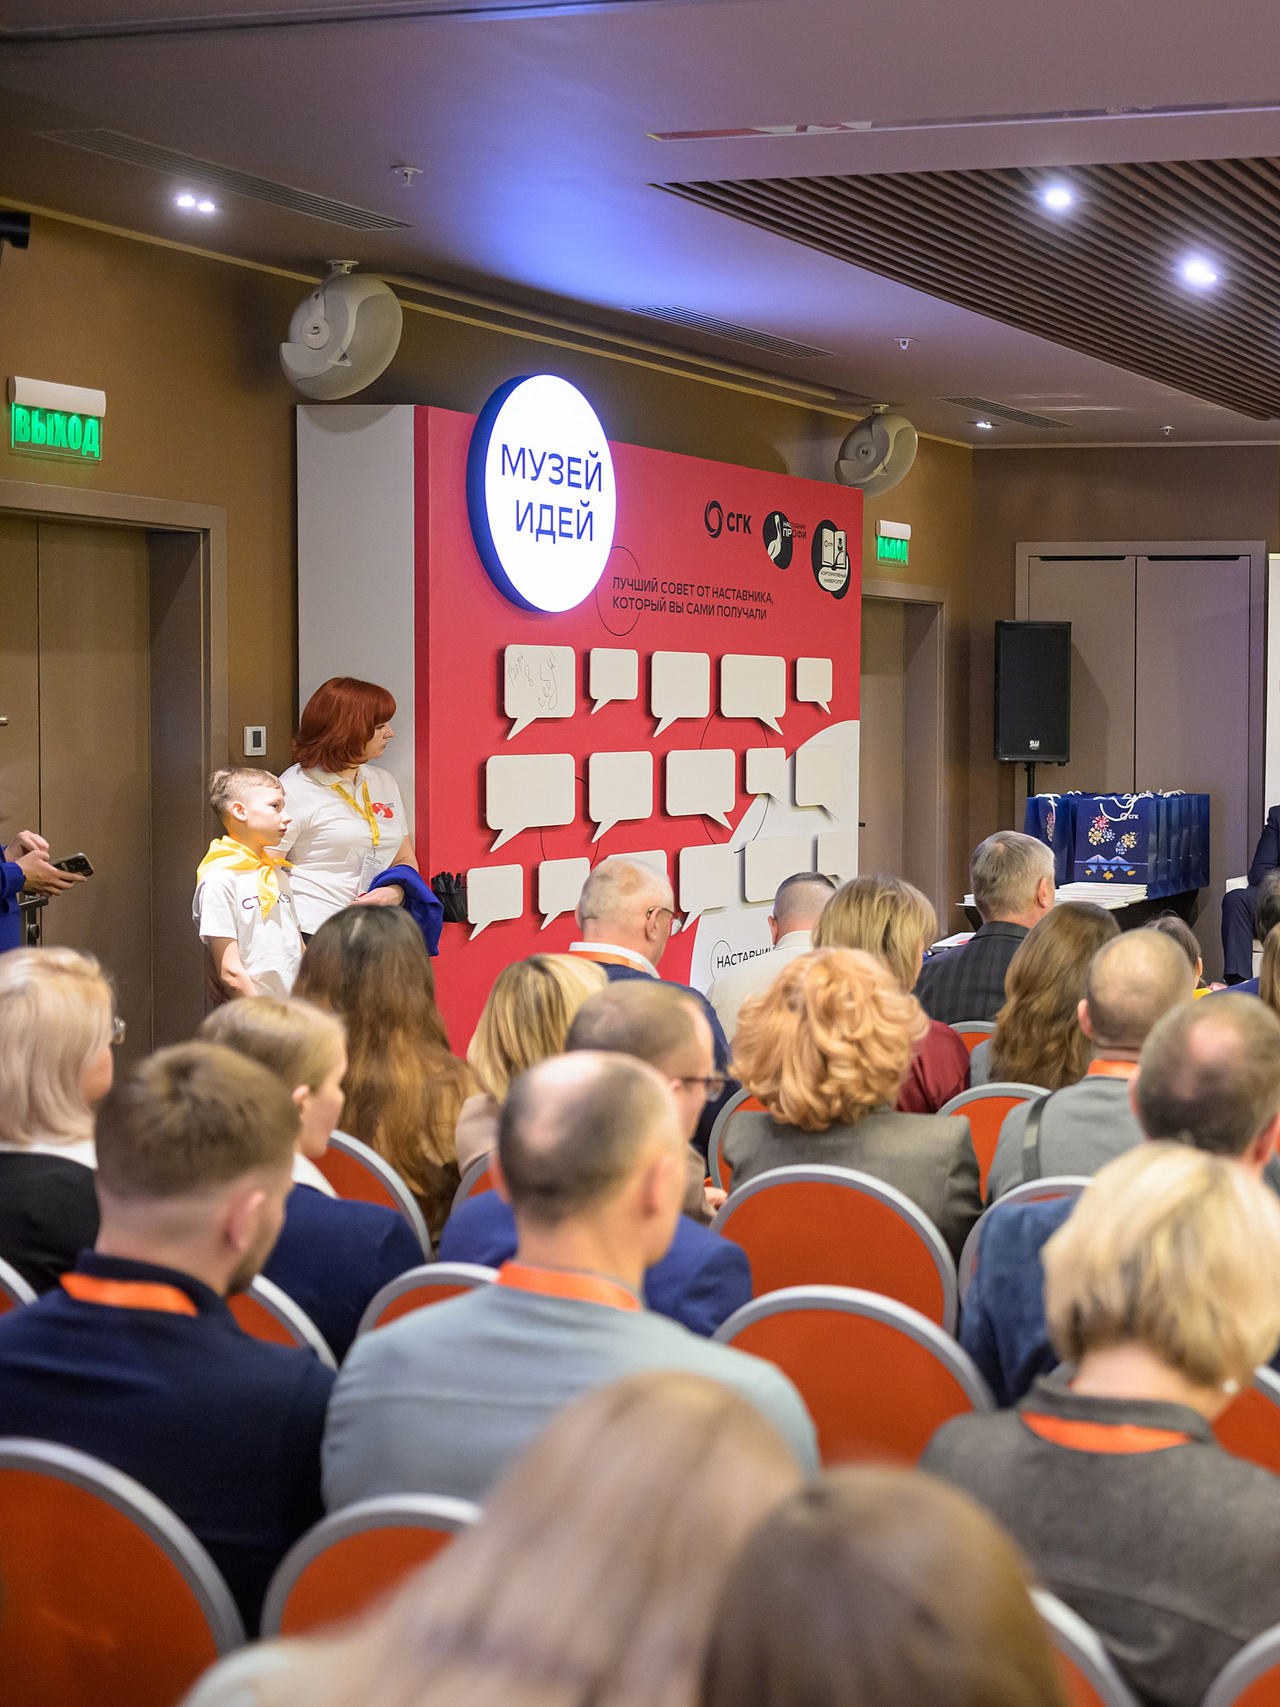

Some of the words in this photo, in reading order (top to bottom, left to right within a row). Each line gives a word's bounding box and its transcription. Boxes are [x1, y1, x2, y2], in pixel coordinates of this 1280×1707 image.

[15, 407, 99, 457] ВЫХОД
[501, 443, 602, 492] МУЗЕЙ
[516, 499, 594, 544] ИДЕЙ
[726, 511, 752, 535] СГК
[783, 528, 807, 539] ПРОФИ
[612, 576, 659, 593] ЛУЧШИЙ
[660, 581, 695, 596] СОВЕТ
[696, 585, 711, 597] ОТ
[711, 587, 774, 606] НАСТАВНИКА,
[612, 596, 667, 613] КОТОРЫЙ
[669, 601, 684, 614] ВЫ
[686, 602, 715, 616] САМИ
[716, 605, 767, 621] ПОЛУЧАЛИ
